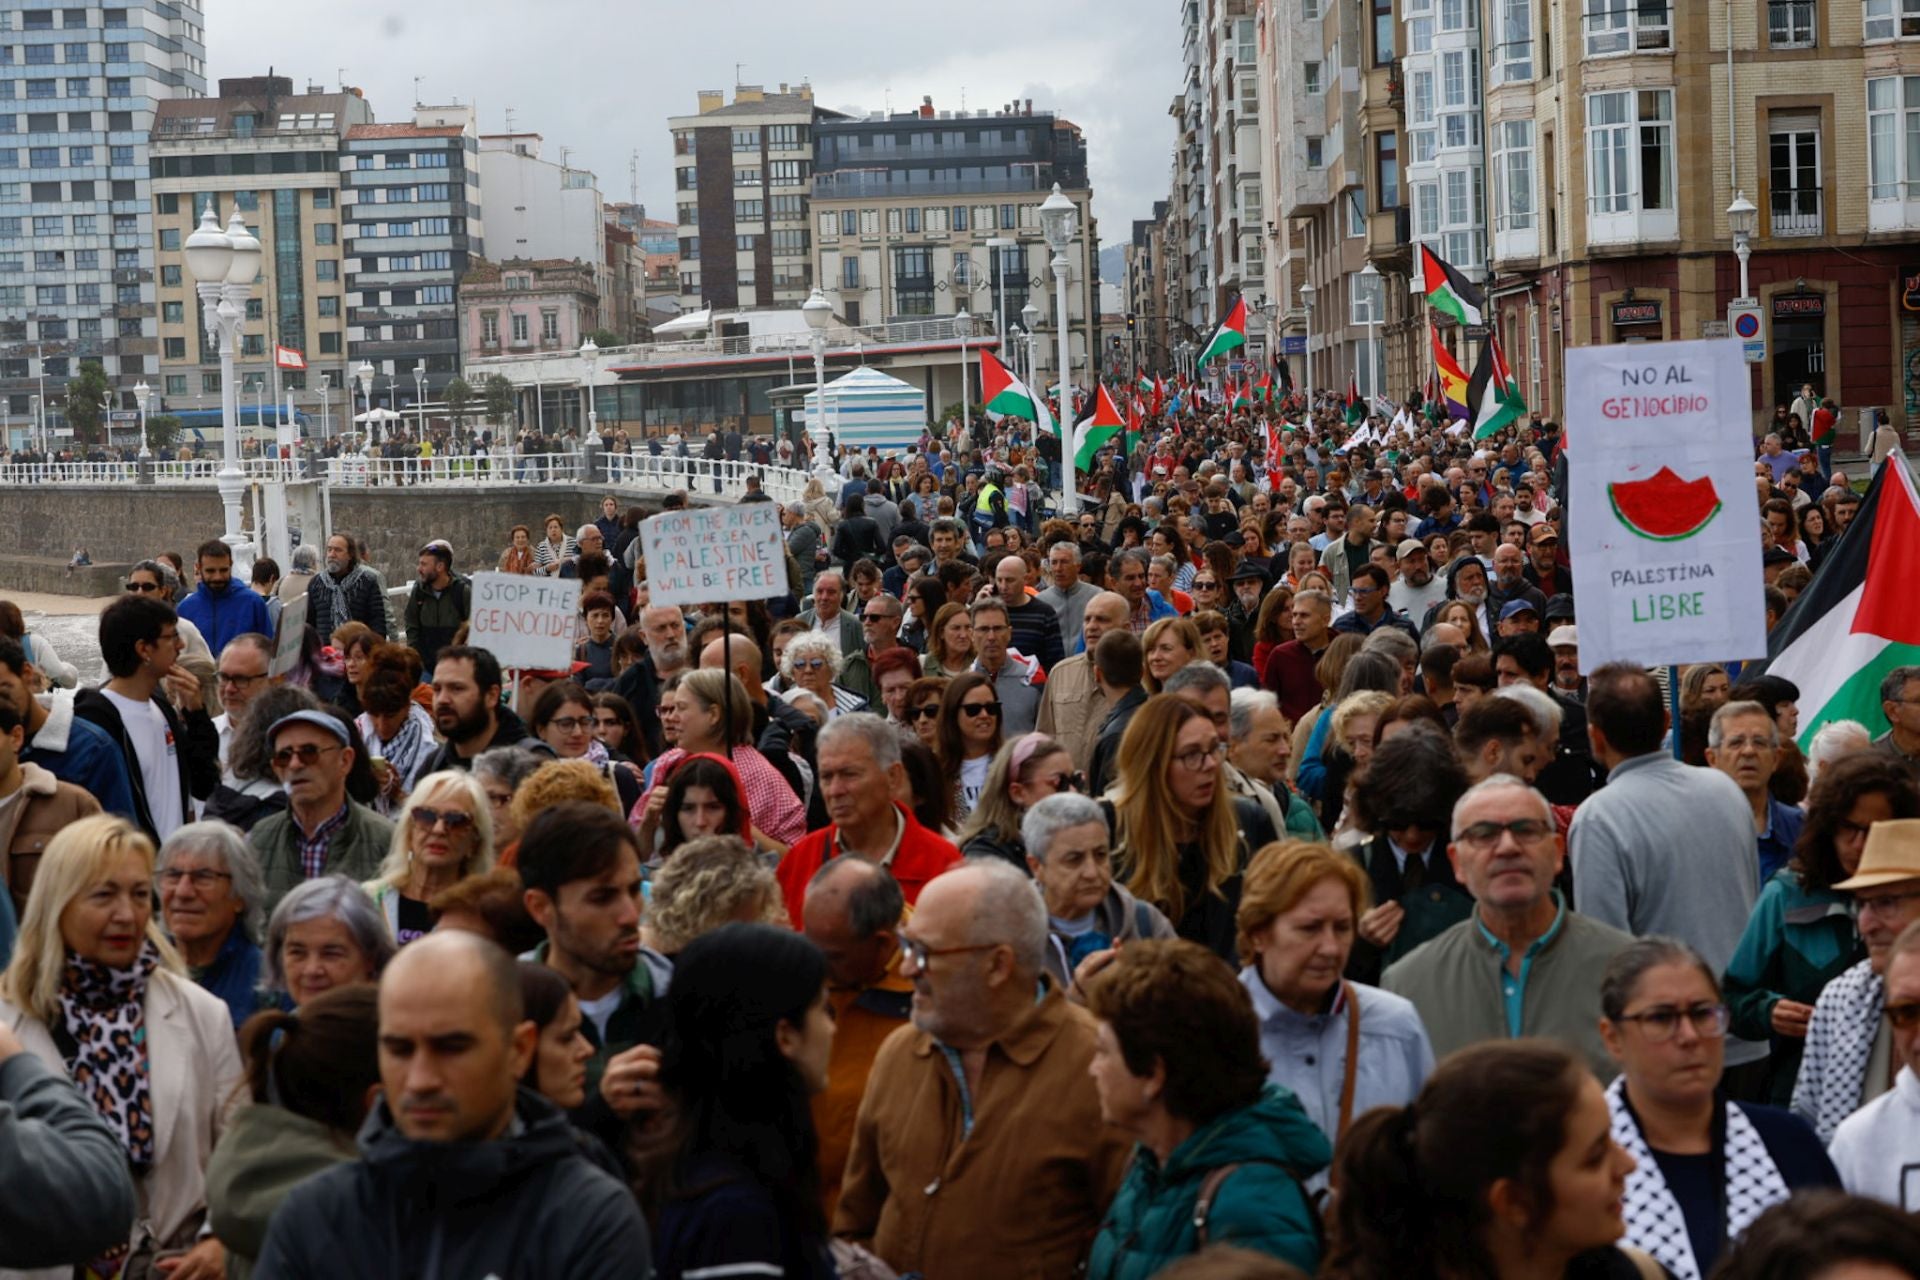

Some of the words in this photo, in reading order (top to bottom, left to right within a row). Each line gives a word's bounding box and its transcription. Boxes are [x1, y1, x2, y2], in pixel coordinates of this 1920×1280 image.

[1617, 305, 1656, 319] UTOPIA
[1775, 298, 1822, 312] UTOPIA
[1622, 367, 1658, 386] NO
[1665, 365, 1693, 384] AL
[1602, 395, 1708, 419] GENOCIDIO
[654, 516, 691, 535] FROM
[696, 514, 722, 529] THE
[729, 509, 775, 527] RIVER
[672, 535, 688, 546] TO
[695, 532, 716, 544] THE
[722, 529, 750, 541] SEA
[664, 542, 769, 571] PALESTINE
[658, 577, 694, 591] WILL
[702, 574, 720, 586] BE
[726, 564, 776, 588] FREE
[1611, 563, 1714, 588] PALESTINA
[481, 582, 530, 602] STOP
[537, 588, 572, 610] THE
[1632, 592, 1704, 623] LIBRE
[475, 608, 576, 639] GENOCIDE
